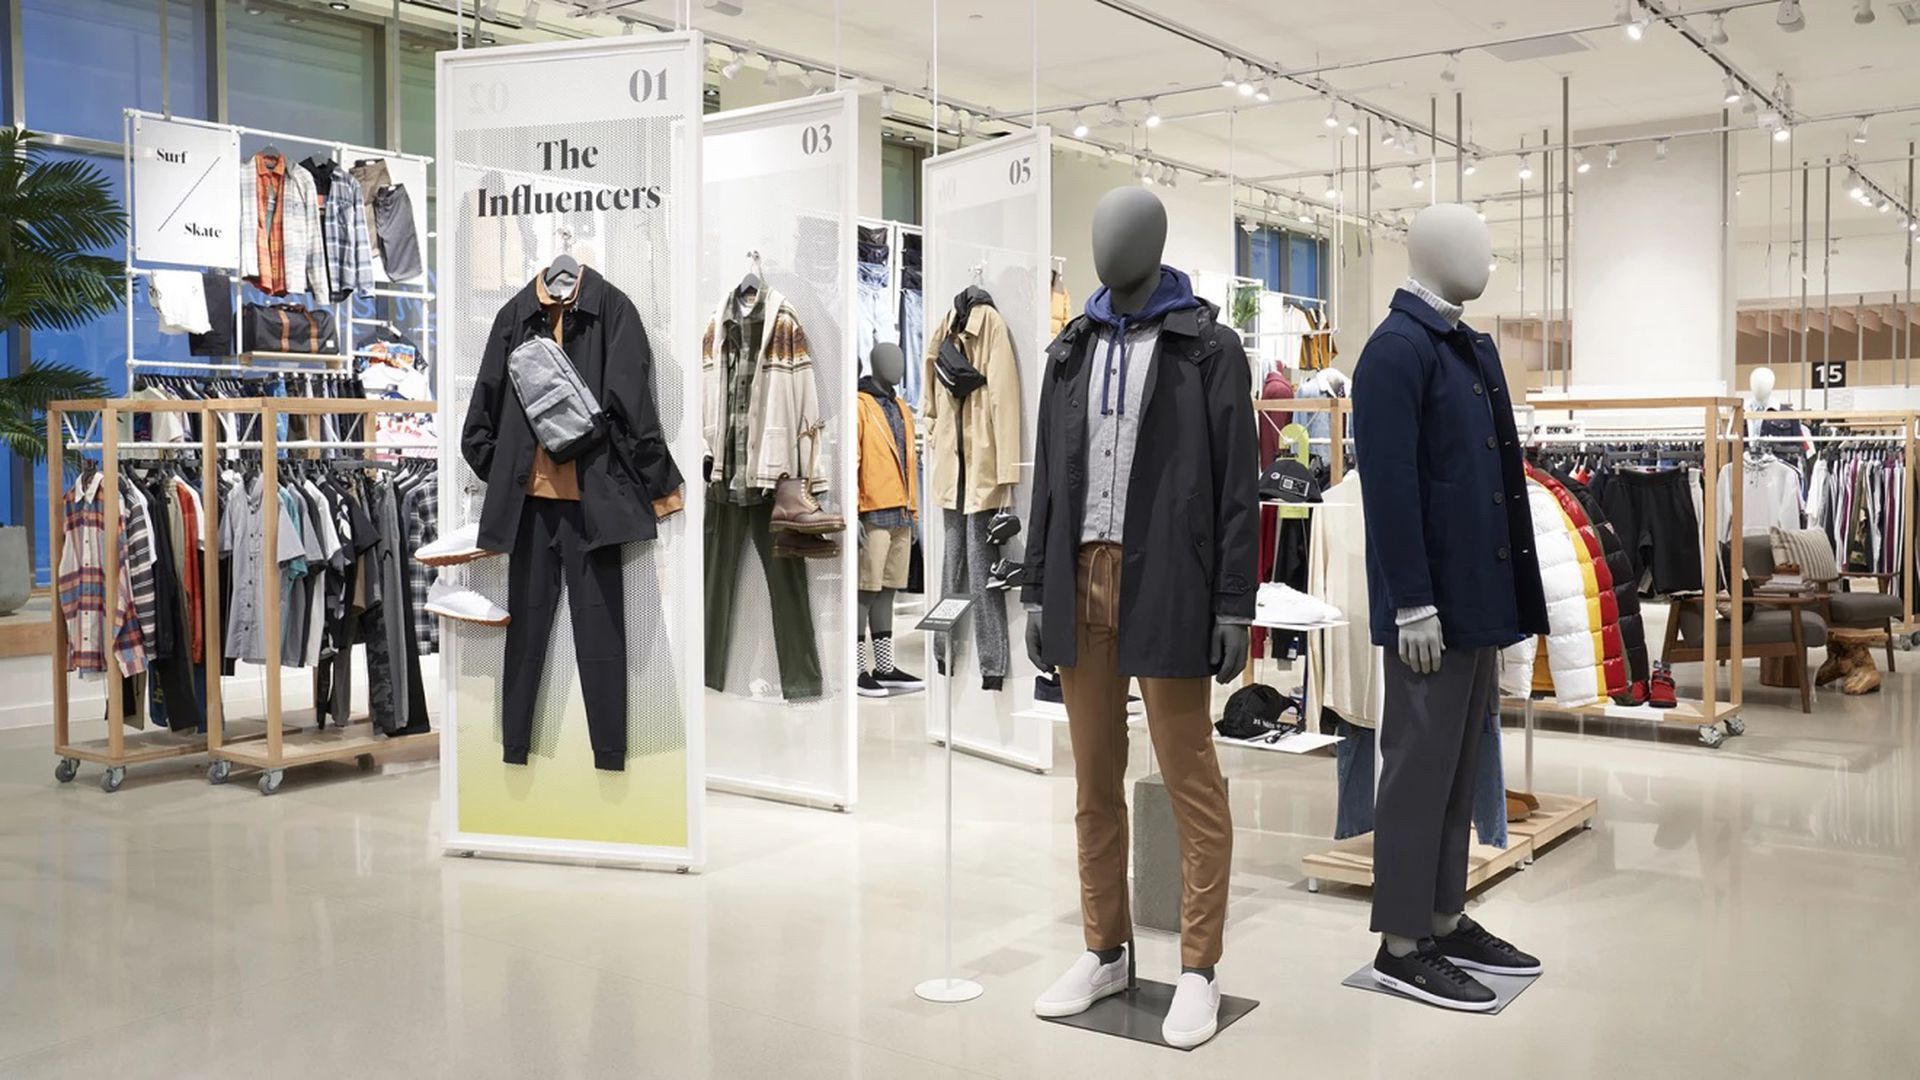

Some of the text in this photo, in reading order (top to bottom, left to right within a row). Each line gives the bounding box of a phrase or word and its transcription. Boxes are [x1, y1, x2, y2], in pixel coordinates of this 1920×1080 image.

[628, 68, 668, 103] 01
[536, 139, 599, 171] The
[801, 124, 834, 156] 03
[156, 148, 188, 164] Surf
[1009, 157, 1032, 186] 05
[477, 183, 662, 218] Influencers
[184, 223, 222, 238] Skate
[1815, 364, 1843, 383] 15
